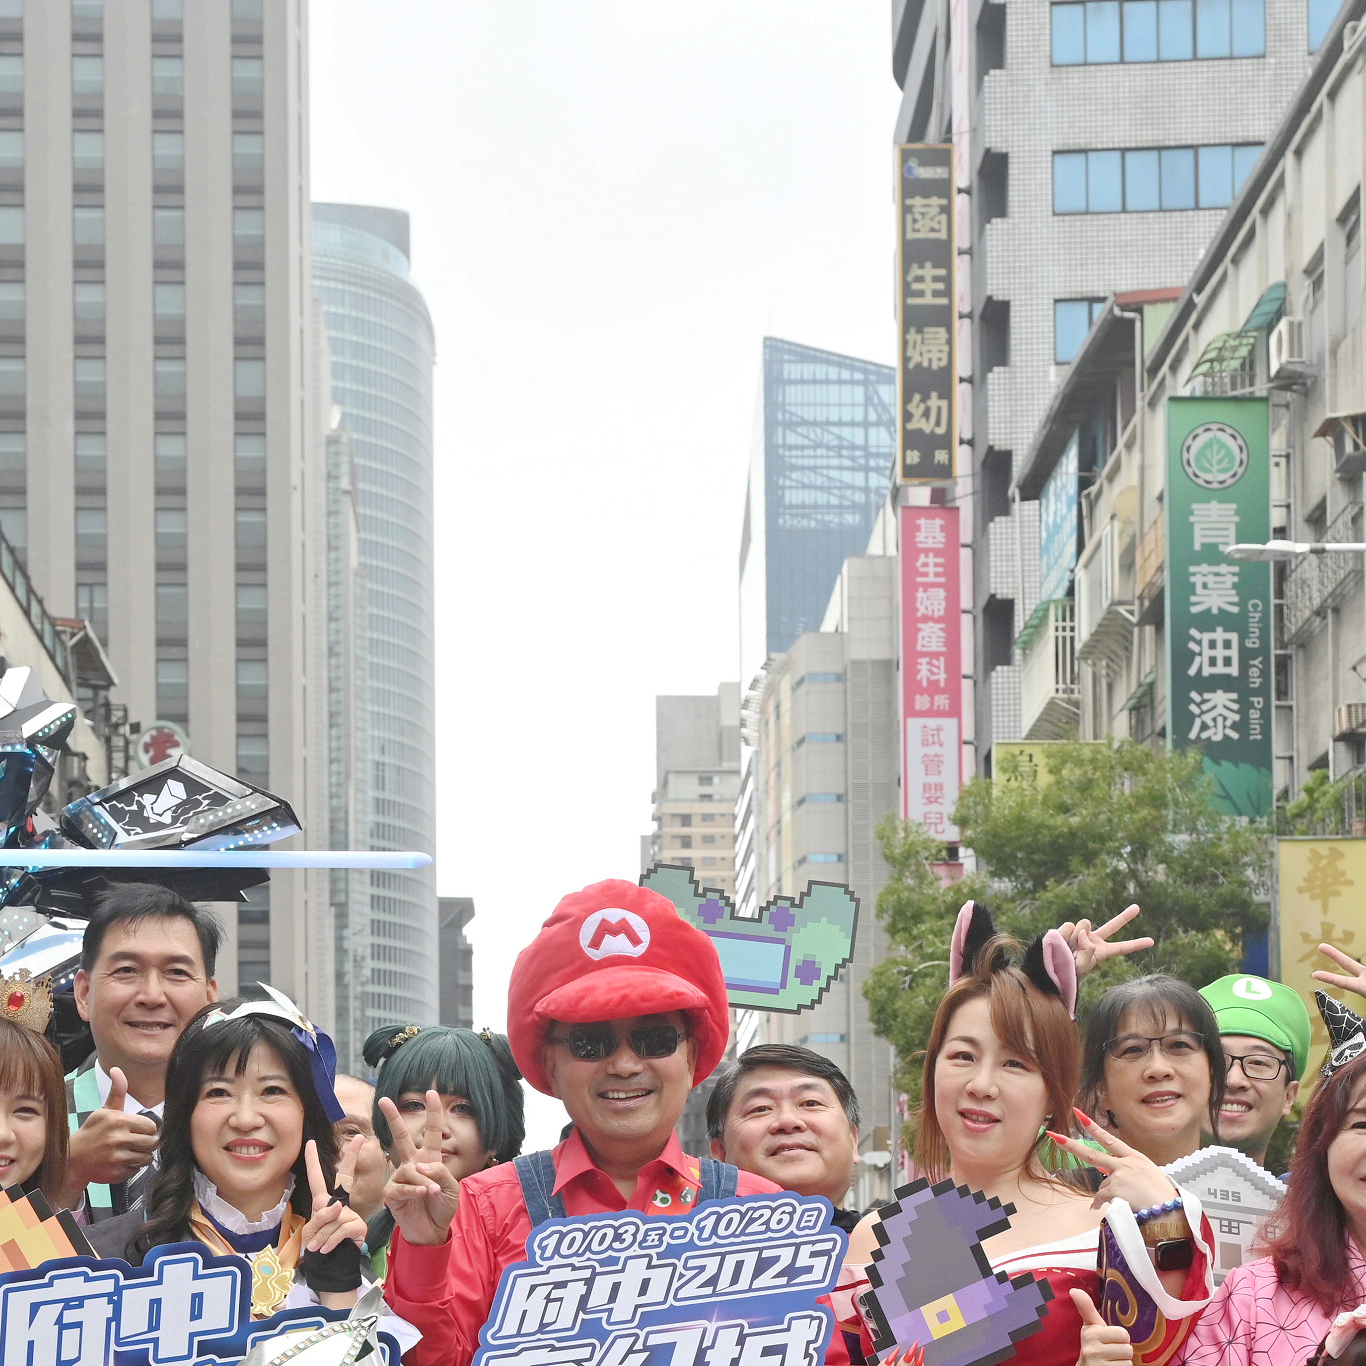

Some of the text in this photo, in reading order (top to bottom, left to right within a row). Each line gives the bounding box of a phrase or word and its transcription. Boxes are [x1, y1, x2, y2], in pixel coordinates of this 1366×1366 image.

[915, 517, 948, 688] 基生婦產科
[1186, 500, 1242, 743] 青葉油漆
[1246, 599, 1264, 742] Ching Yeh Paint
[588, 916, 644, 951] M
[1245, 981, 1262, 995] L
[1207, 1187, 1242, 1203] 435
